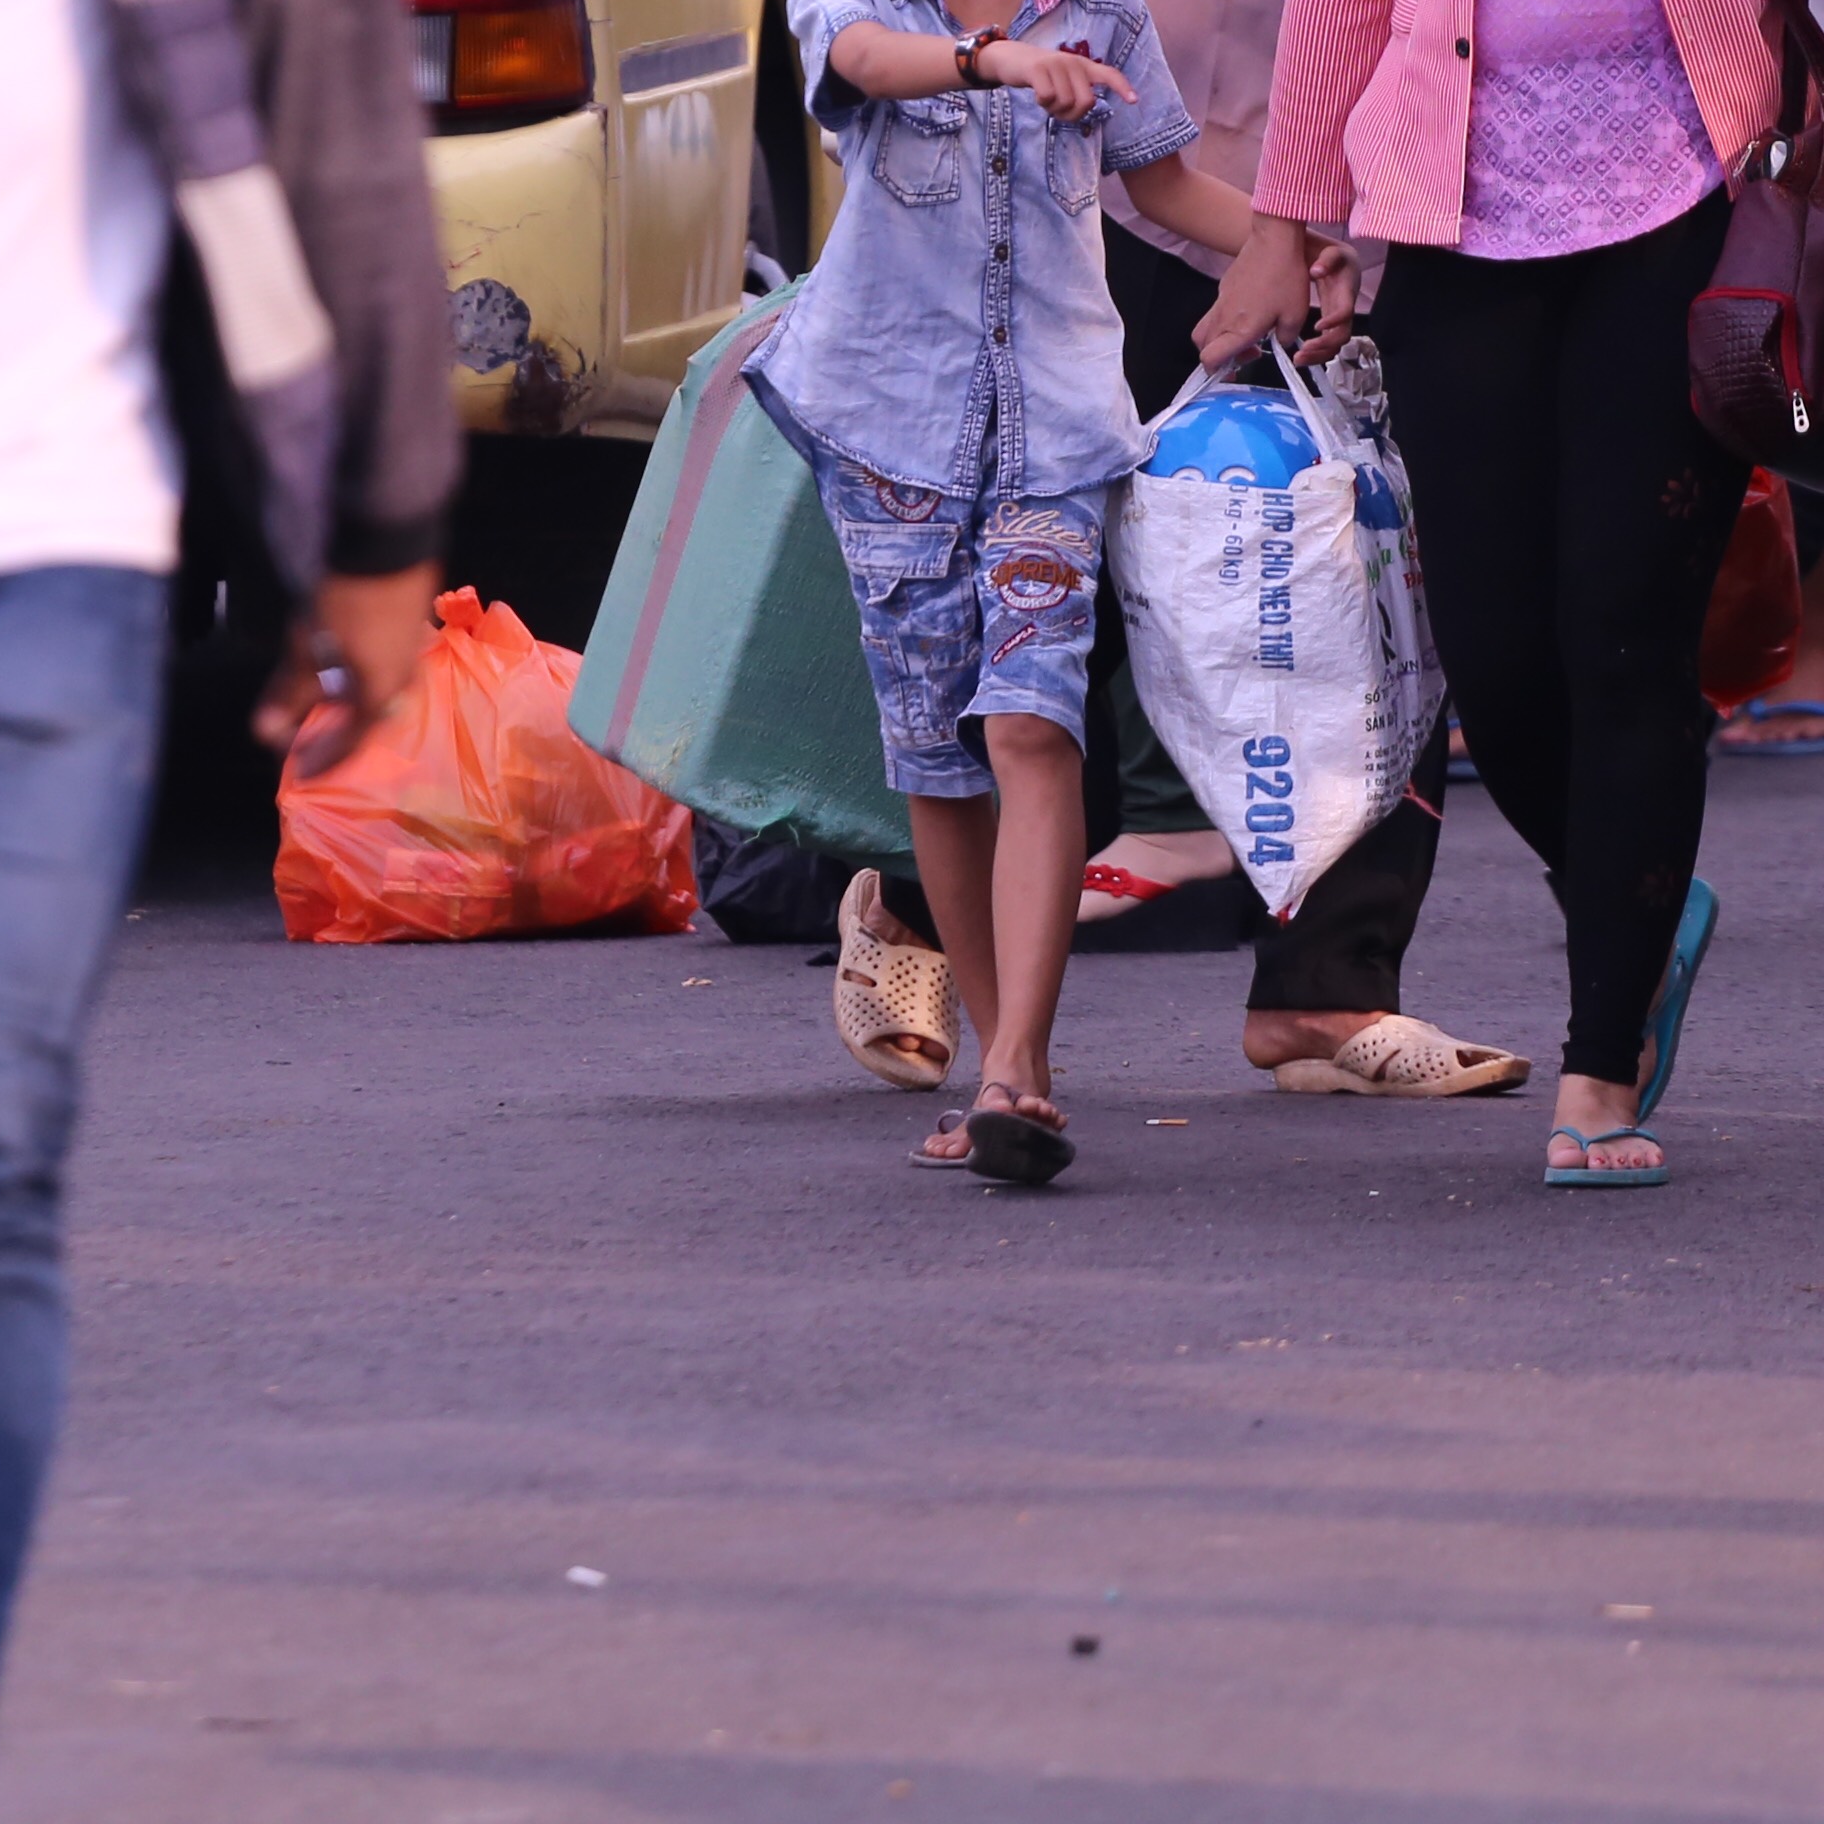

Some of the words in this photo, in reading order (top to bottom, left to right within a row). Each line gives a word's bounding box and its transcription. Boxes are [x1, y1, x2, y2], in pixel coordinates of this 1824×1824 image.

[1260, 539, 1295, 580] CHO
[1259, 585, 1293, 626] HEO
[1252, 631, 1296, 672] THỊT
[1242, 733, 1297, 868] 9204
